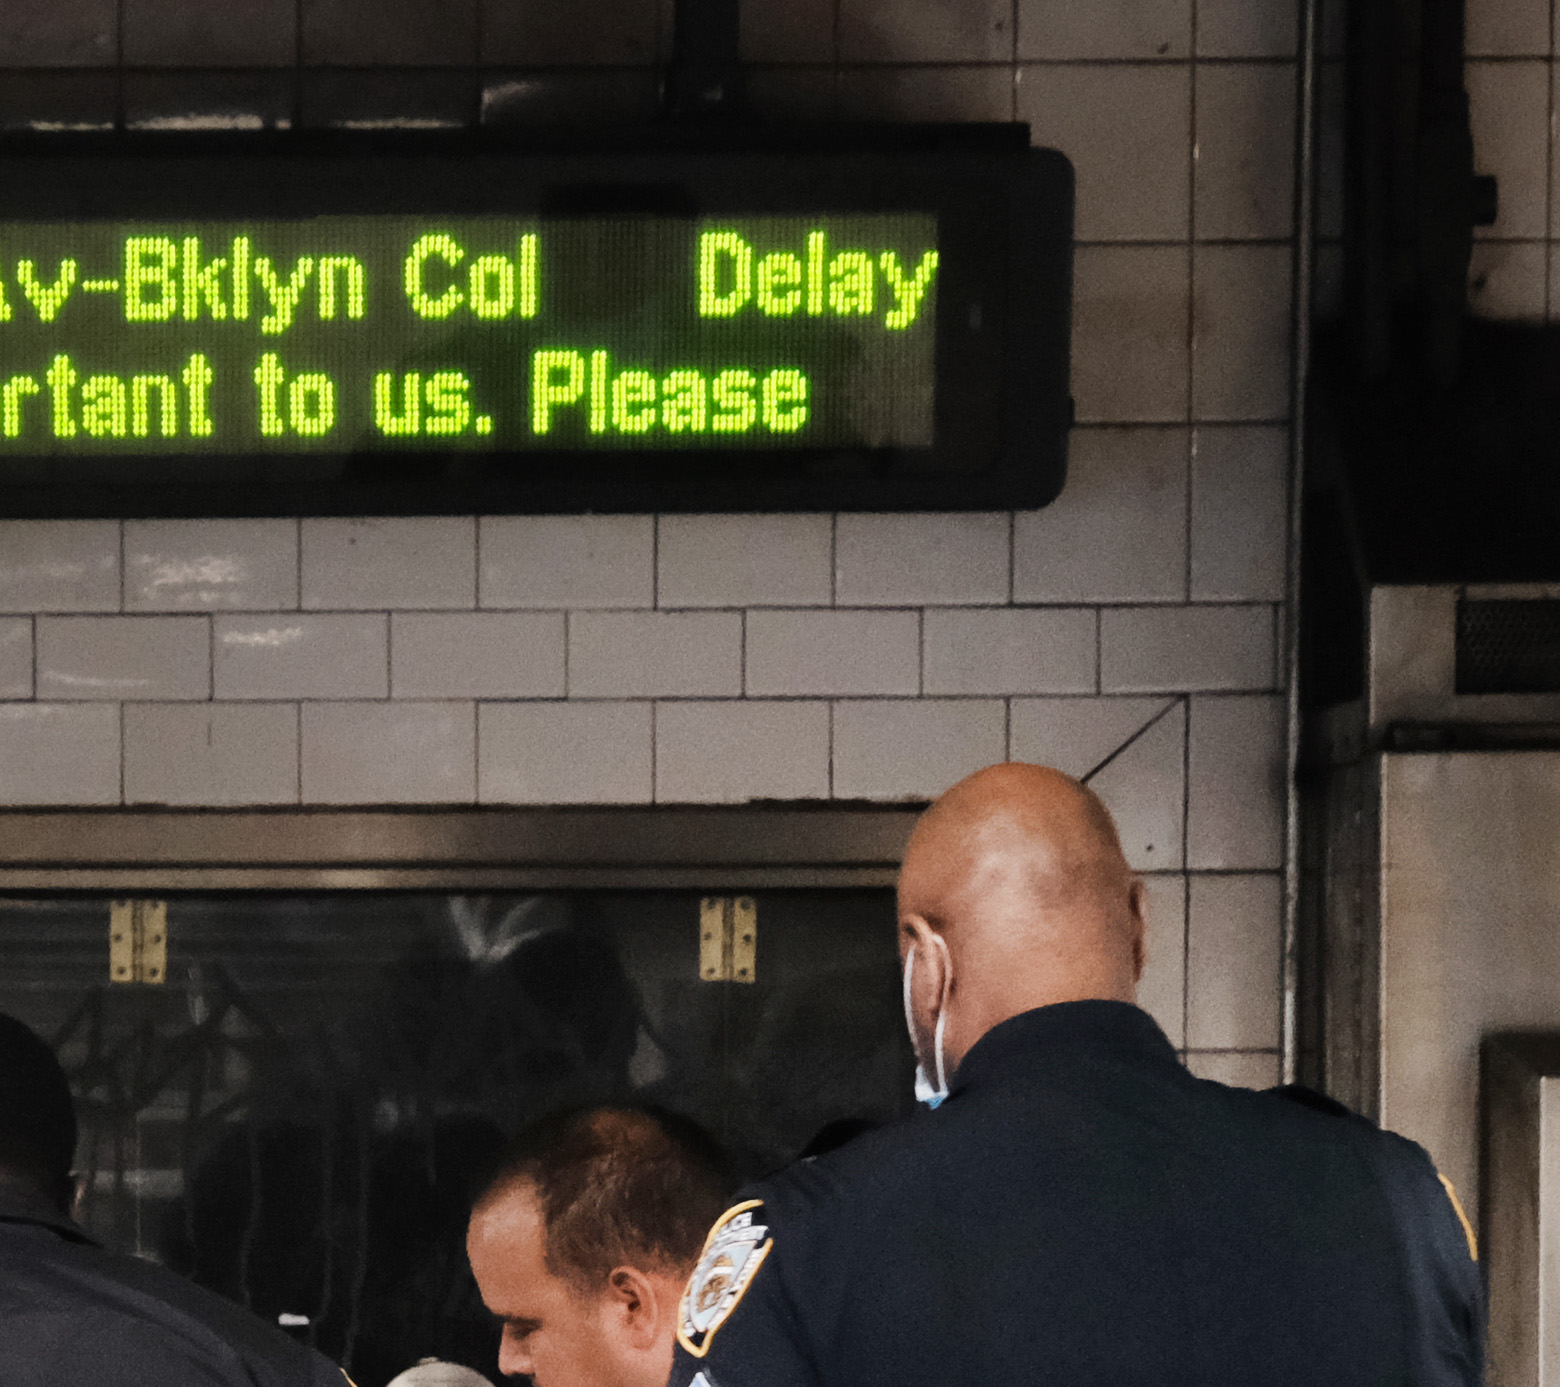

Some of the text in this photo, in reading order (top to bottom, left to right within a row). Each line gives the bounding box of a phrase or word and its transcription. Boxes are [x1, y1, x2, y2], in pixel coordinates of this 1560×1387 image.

[404, 233, 541, 321] Col
[698, 230, 940, 330] Delay
[253, 352, 336, 438] to
[374, 370, 494, 437] us.
[532, 348, 810, 436] Please
